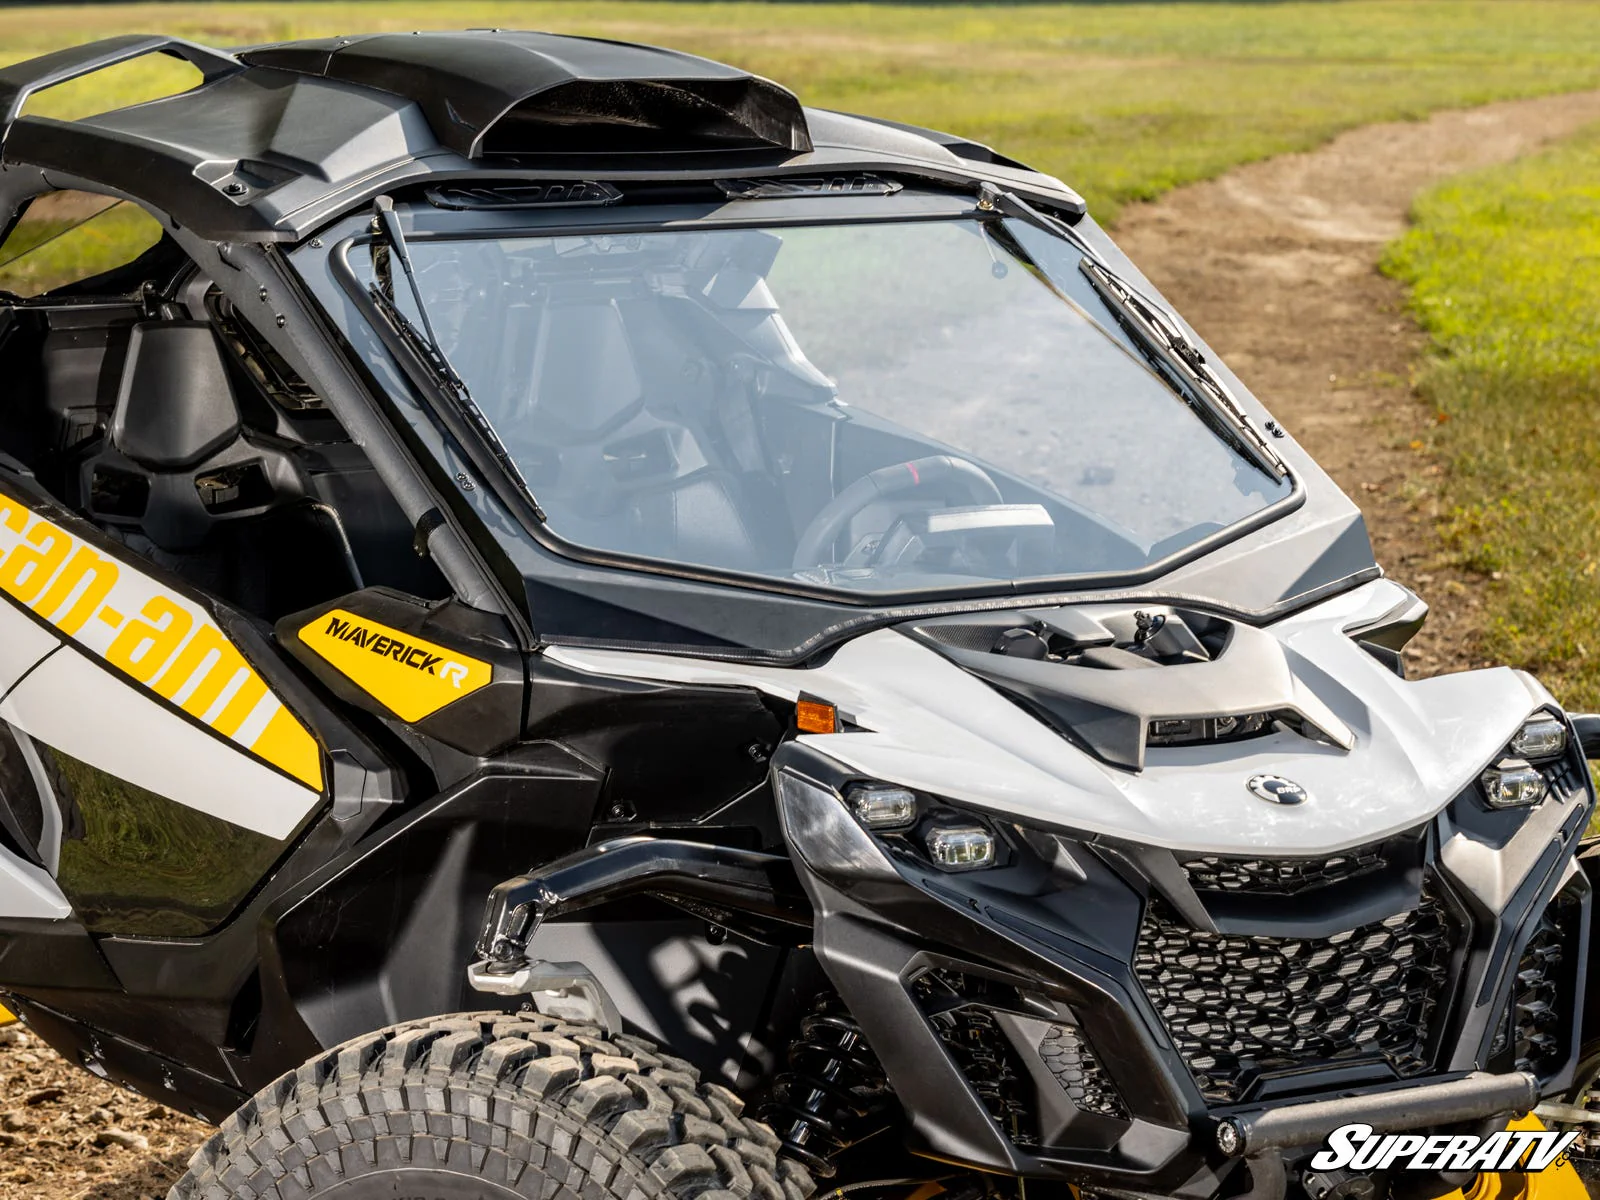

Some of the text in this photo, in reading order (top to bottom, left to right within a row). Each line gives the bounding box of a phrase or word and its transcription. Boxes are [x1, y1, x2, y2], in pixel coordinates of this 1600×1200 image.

[325, 617, 469, 689] MAVERICK R
[1276, 786, 1301, 794] BRP
